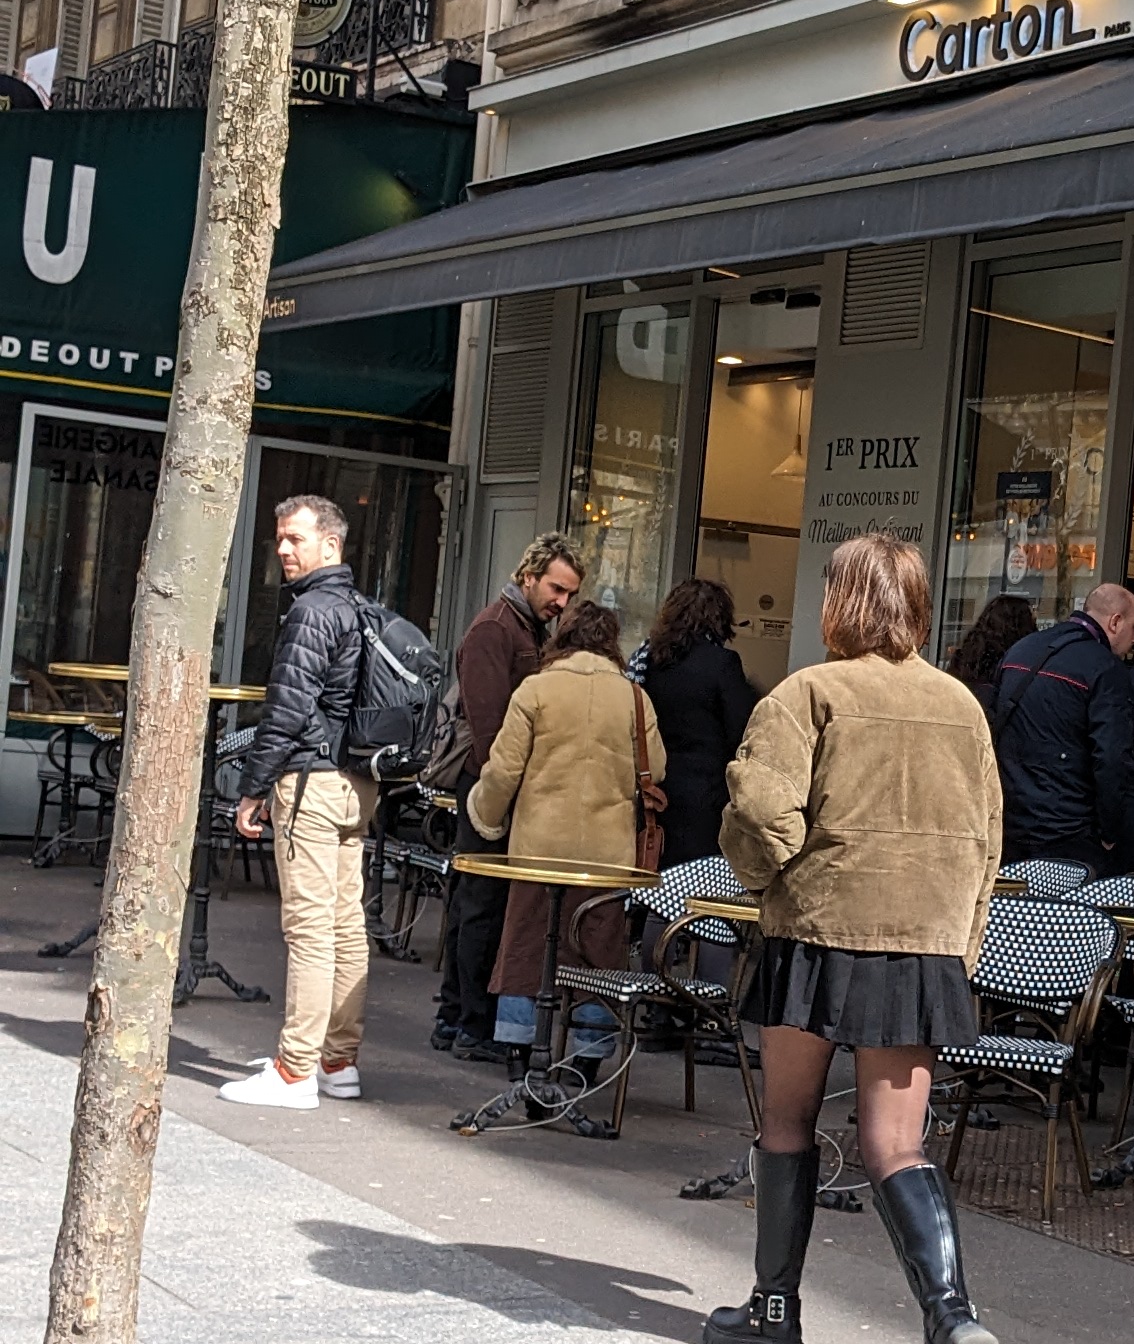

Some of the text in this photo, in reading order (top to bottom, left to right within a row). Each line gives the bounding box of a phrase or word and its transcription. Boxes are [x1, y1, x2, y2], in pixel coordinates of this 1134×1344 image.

[1104, 21, 1131, 39] PARIS
[263, 296, 296, 320] Artisan
[858, 437, 920, 469] PRIX
[819, 491, 920, 507] AU CONCOURS DU
[807, 519, 862, 544] Meilleur
